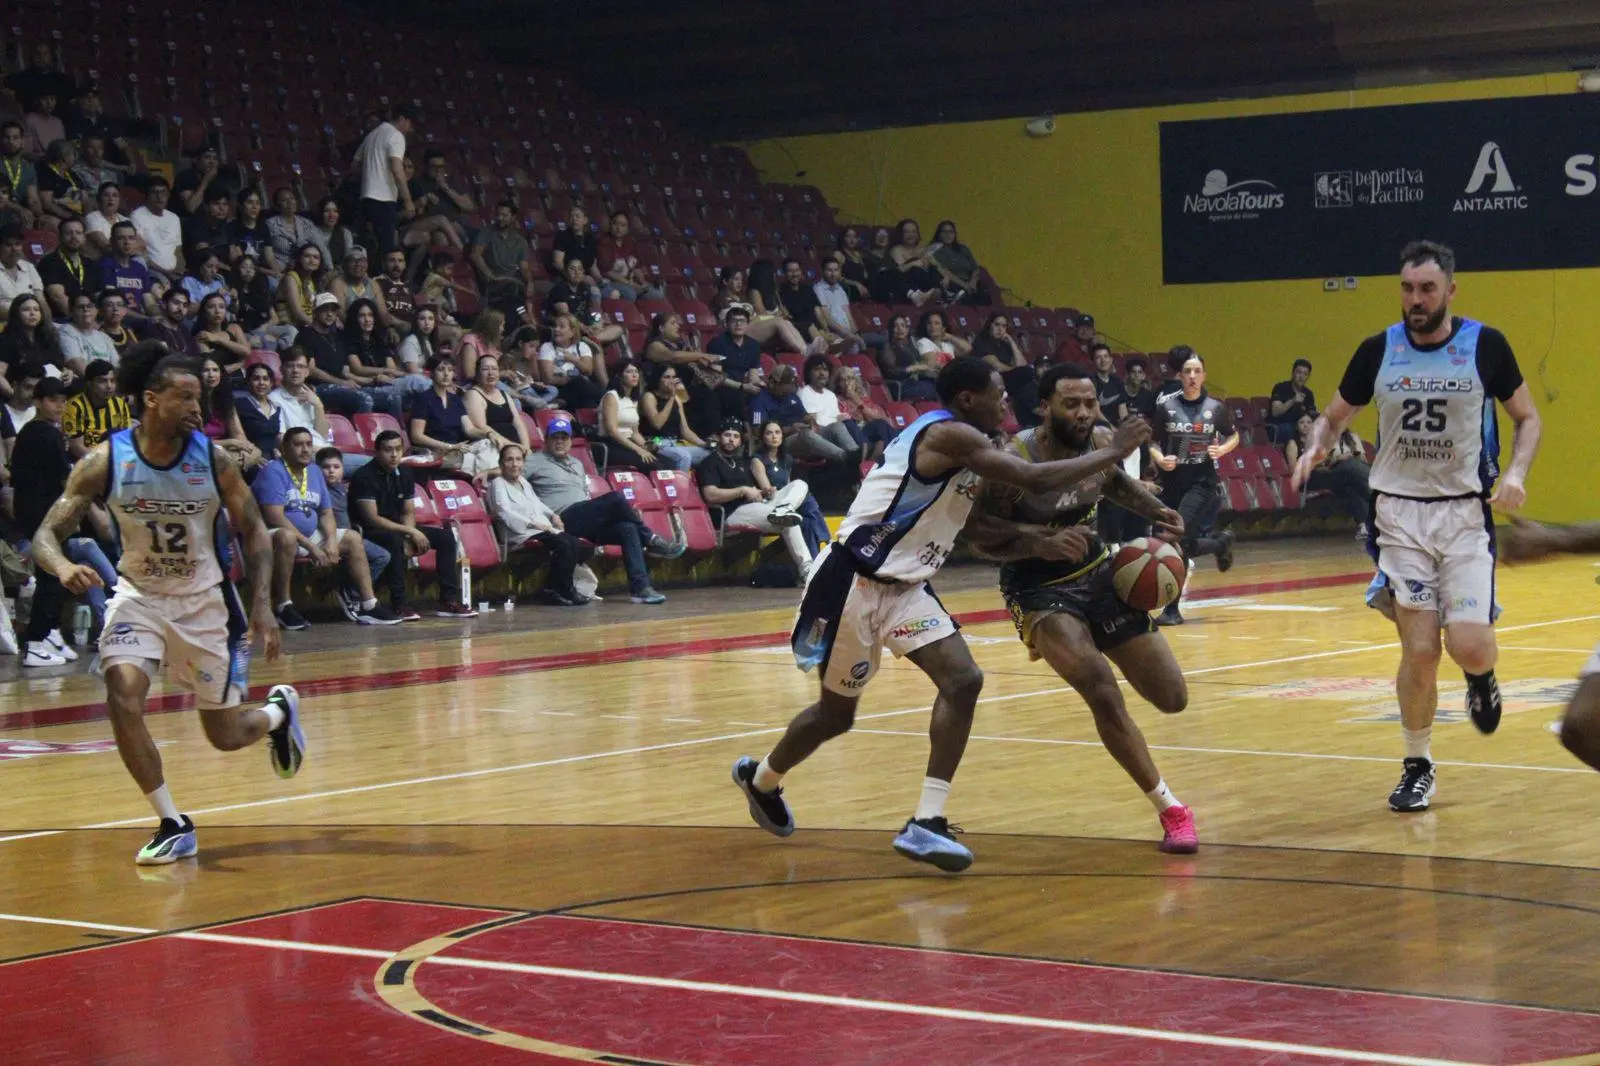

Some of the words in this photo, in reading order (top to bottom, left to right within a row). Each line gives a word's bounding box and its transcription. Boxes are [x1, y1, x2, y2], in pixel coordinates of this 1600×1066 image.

[1183, 191, 1285, 213] NavolaTours
[1453, 196, 1529, 212] ANTARTIC
[1386, 376, 1473, 392] ASTROS
[1402, 398, 1448, 432] 25
[1397, 436, 1409, 446] AL
[1412, 438, 1453, 448] ESTILO
[1399, 447, 1452, 461] Jalisco
[120, 496, 210, 514] ASTROS
[146, 520, 188, 554] 12
[104, 636, 141, 646] MEGA
